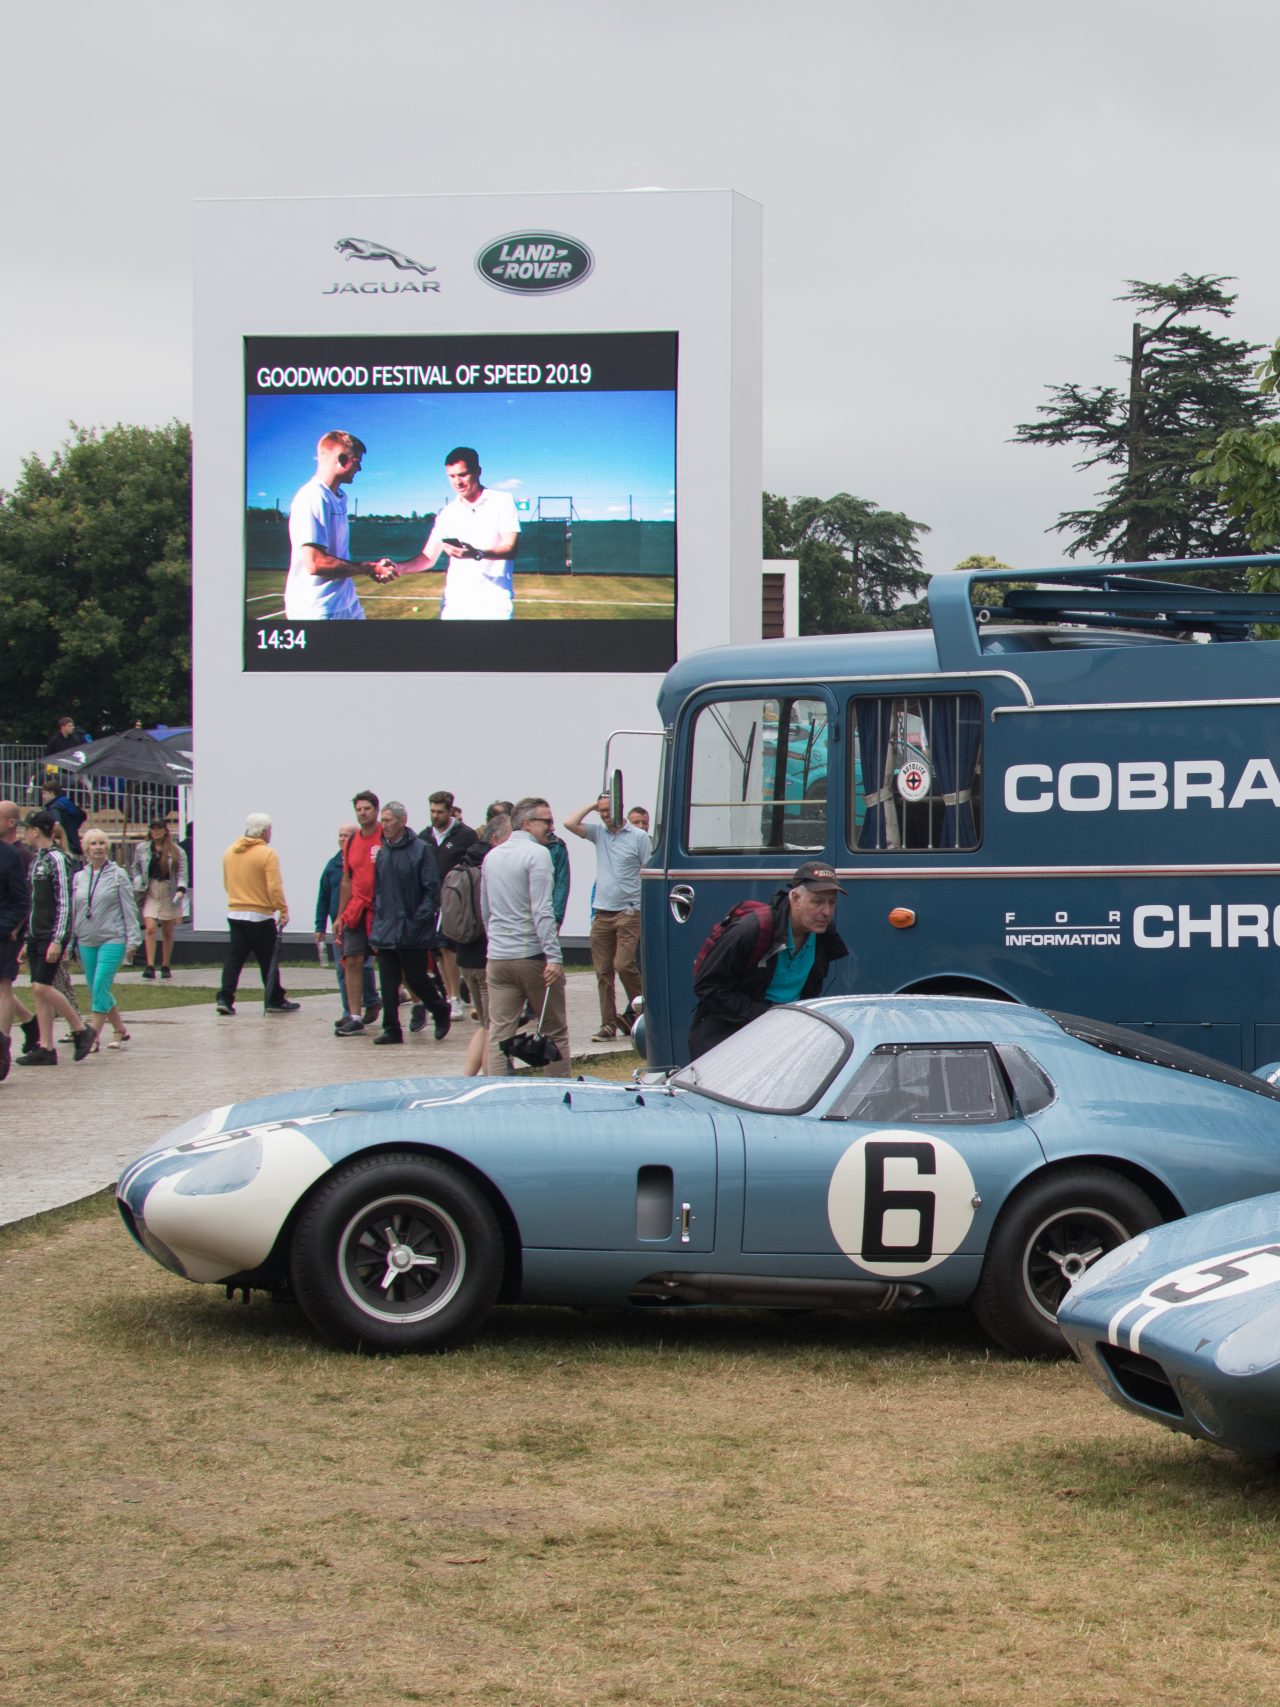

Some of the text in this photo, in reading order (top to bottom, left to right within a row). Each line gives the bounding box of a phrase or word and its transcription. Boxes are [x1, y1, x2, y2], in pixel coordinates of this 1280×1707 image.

[499, 244, 556, 262] LAND
[504, 262, 572, 279] ROVER
[322, 281, 441, 294] JAGUAR
[257, 363, 592, 387] GOODWOOD FESTIVAL OF SPEED 2019
[256, 629, 306, 650] 14:34
[1005, 932, 1121, 946] INFORMATION
[861, 1141, 937, 1263] 6
